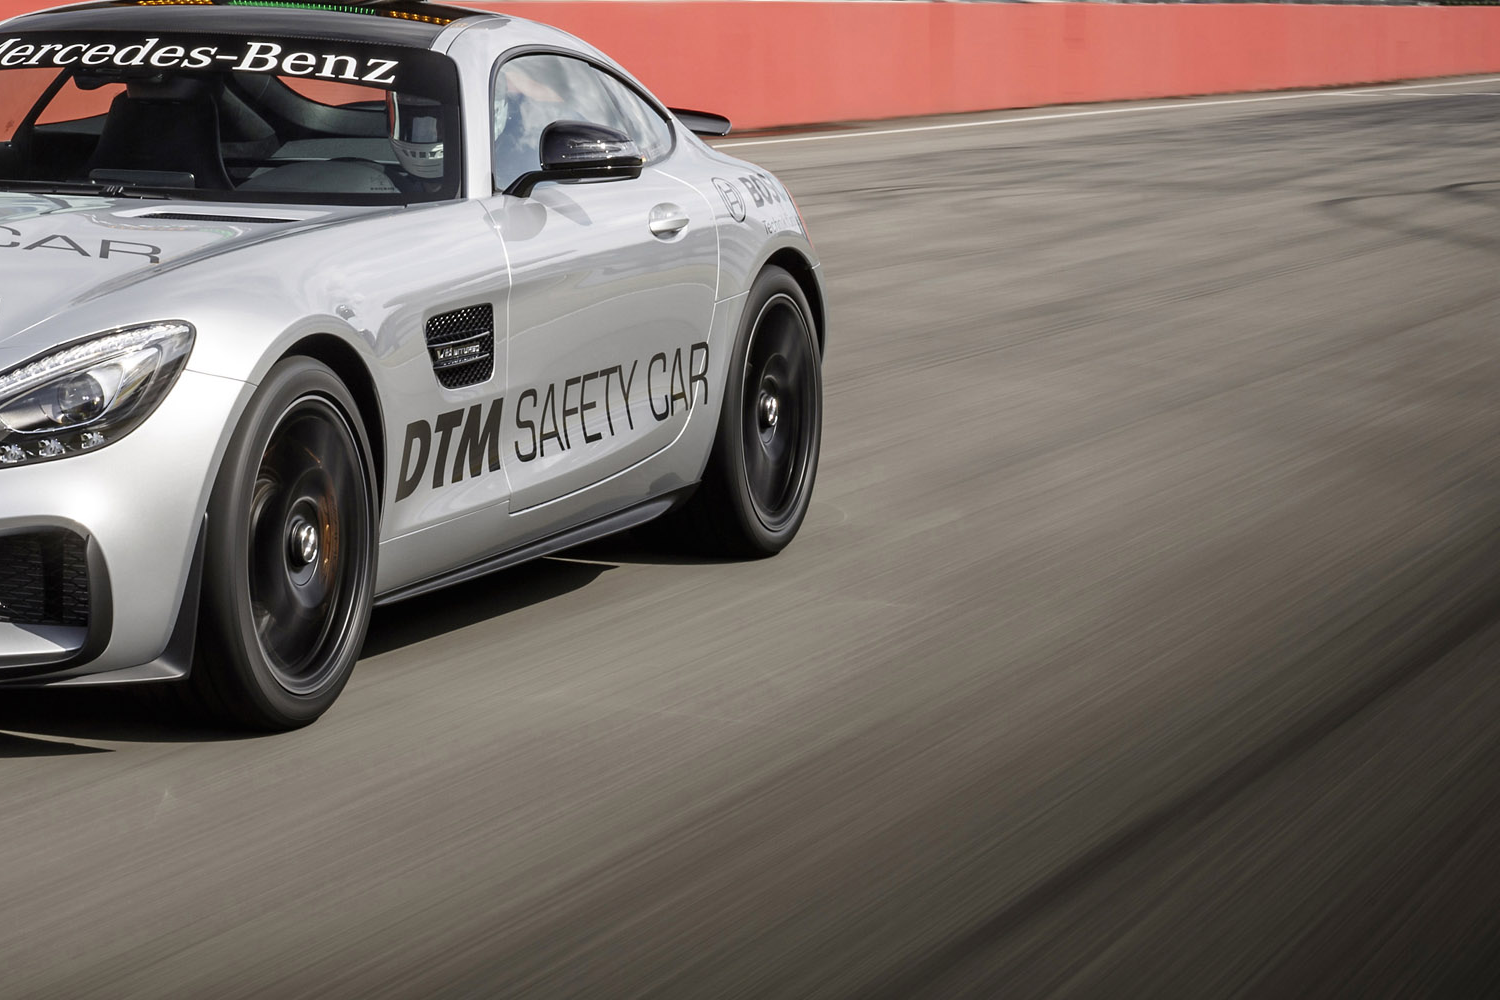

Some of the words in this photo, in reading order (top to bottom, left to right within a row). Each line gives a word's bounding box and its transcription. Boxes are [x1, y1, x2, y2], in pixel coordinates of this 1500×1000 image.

[395, 397, 504, 503] DTM
[515, 359, 638, 462] SAFETY
[647, 341, 709, 421] CAR
